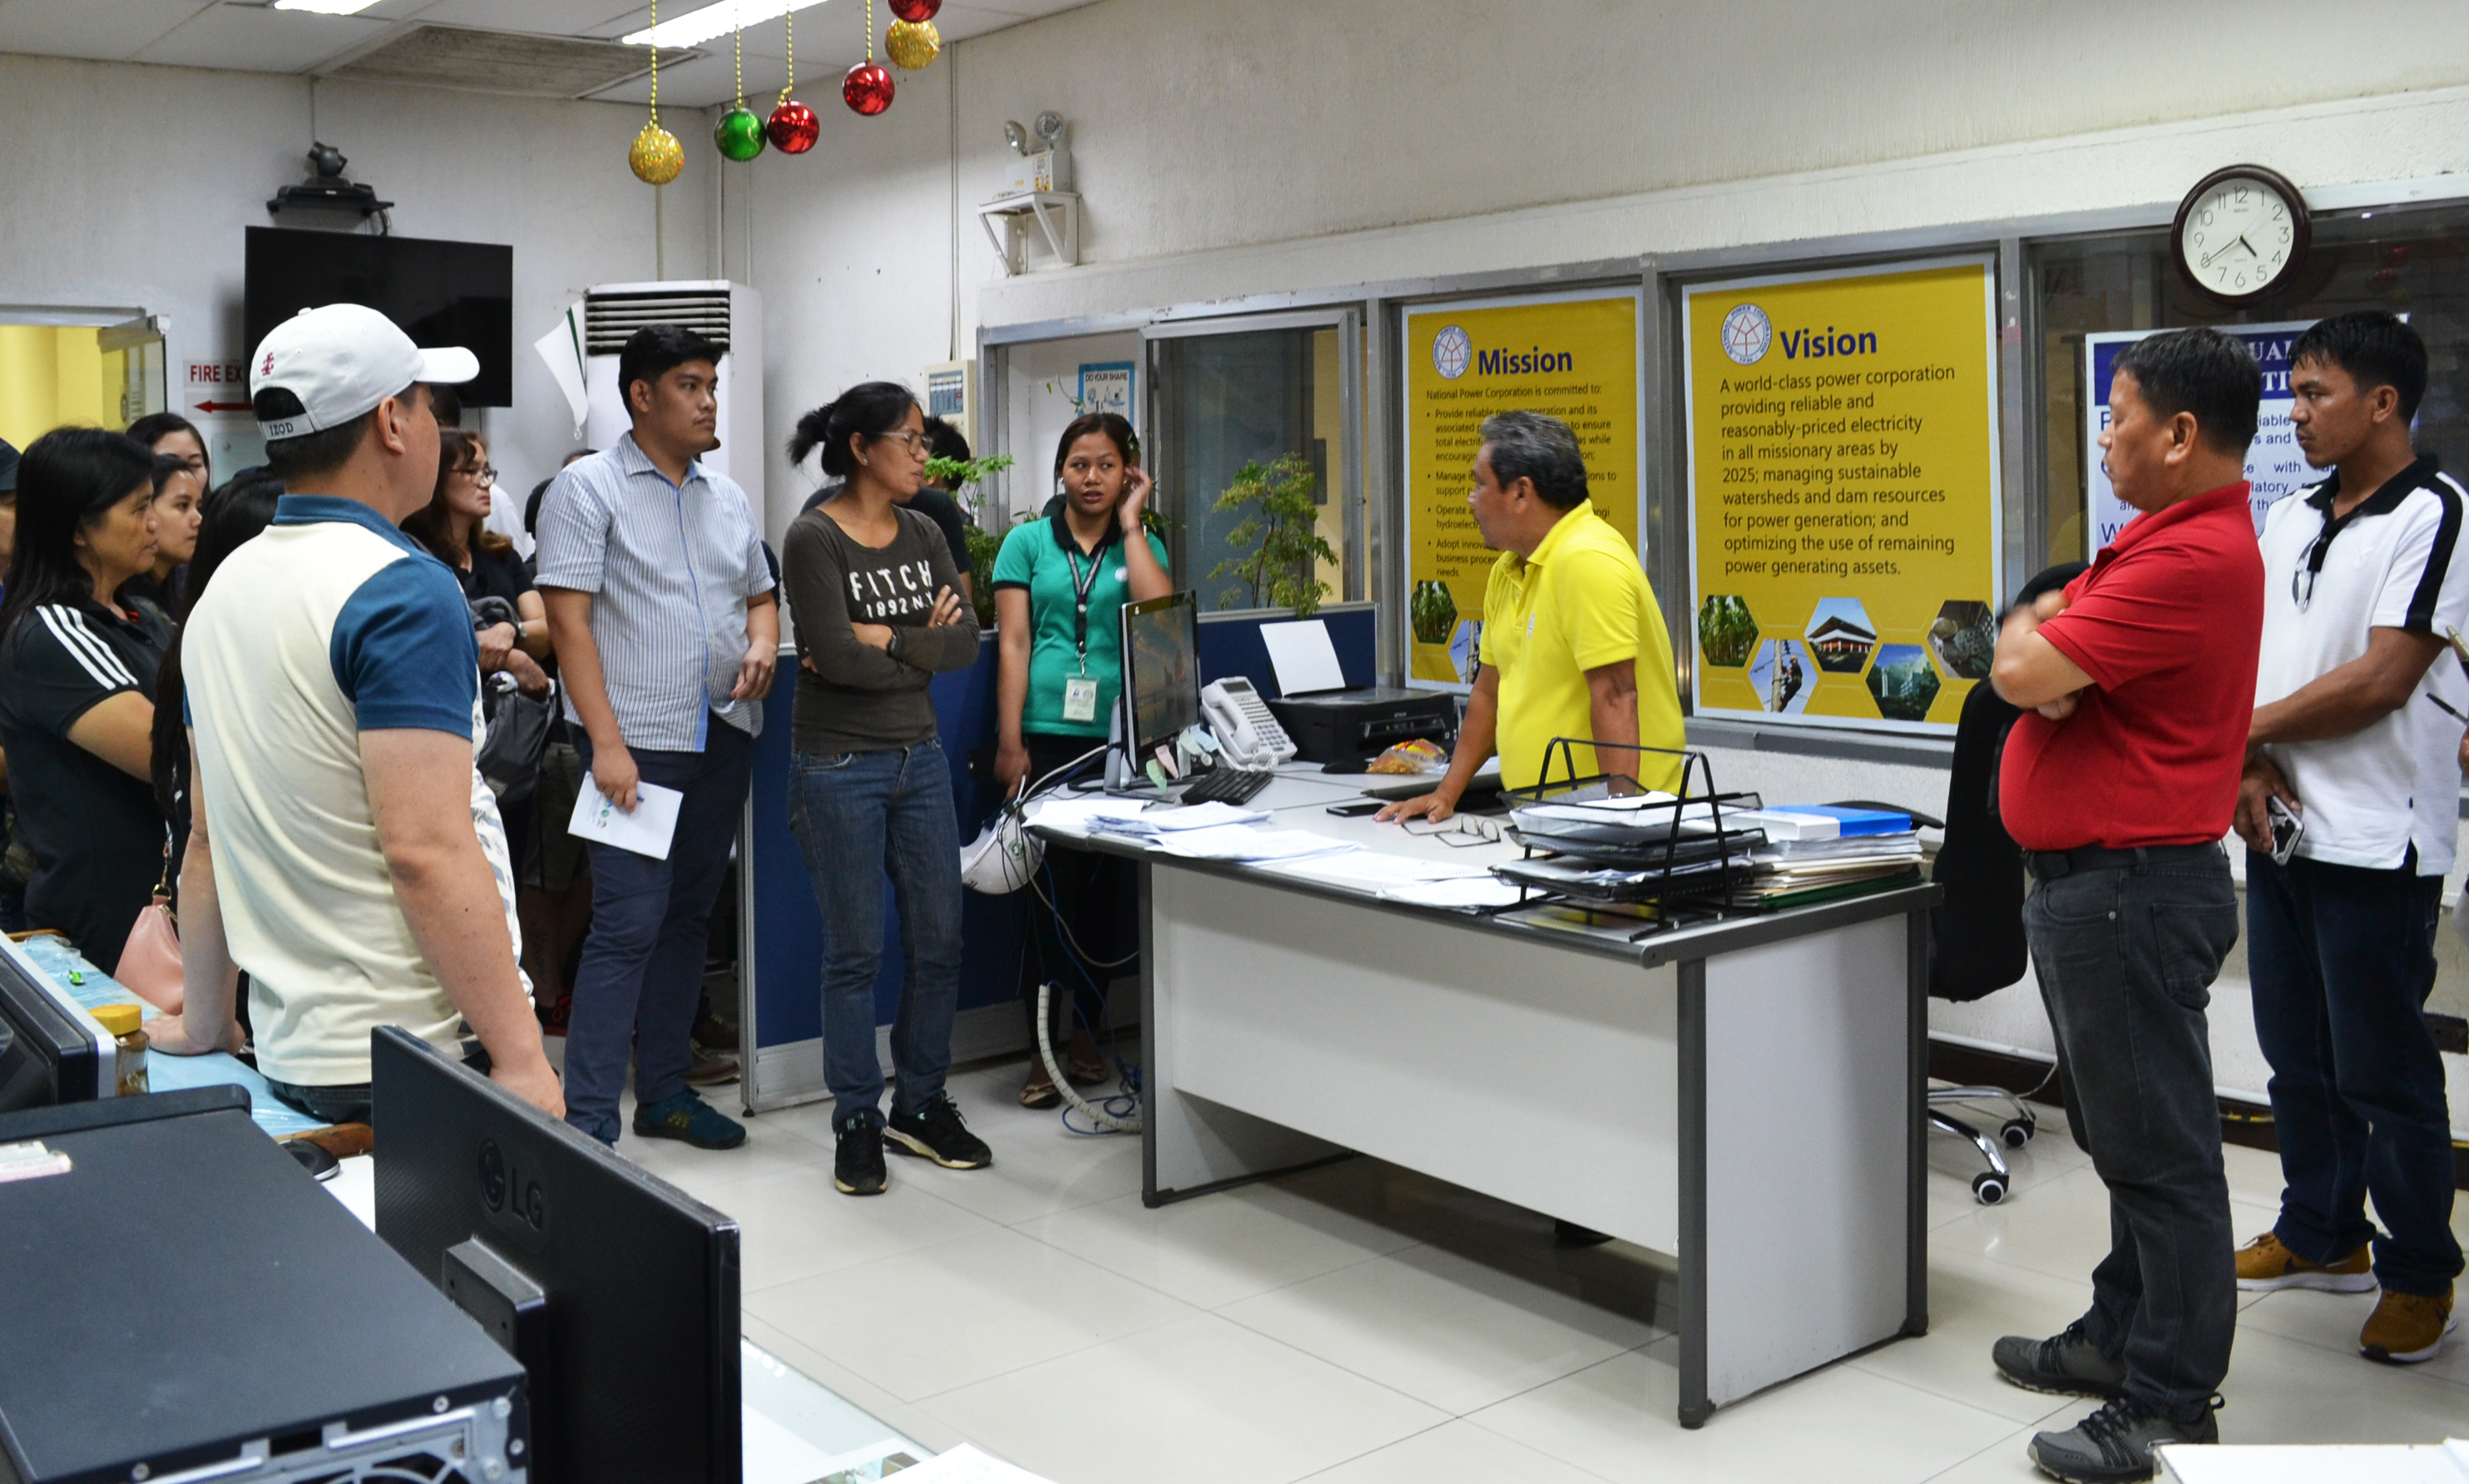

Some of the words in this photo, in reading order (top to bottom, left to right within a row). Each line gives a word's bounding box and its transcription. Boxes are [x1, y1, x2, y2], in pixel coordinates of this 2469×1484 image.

[2217, 192, 2226, 210] 11
[2234, 186, 2249, 204] 12
[2260, 190, 2265, 207] 1
[2198, 210, 2214, 227] 10
[2273, 204, 2283, 221] 2
[2194, 231, 2204, 249] 9
[2279, 226, 2289, 244] 3
[2200, 252, 2210, 269] 8
[2271, 250, 2282, 266] 4
[2218, 266, 2227, 284] 7
[2235, 271, 2246, 288] 6
[2256, 265, 2267, 282] 5
[1779, 325, 1878, 360] Vision
[1478, 346, 1573, 376] Mission
[190, 364, 220, 382] FIRE
[225, 364, 243, 382] EX
[1085, 373, 1094, 382] DO
[1095, 372, 1108, 382] YOUR
[1109, 371, 1128, 380] SHARE
[1720, 378, 1730, 393] A
[1734, 374, 1812, 393] world-class
[1816, 372, 1861, 391] power
[1866, 364, 1956, 388] corporation
[1427, 389, 1457, 399] National
[1460, 388, 1483, 398] Power
[1486, 386, 1532, 399] Corporation
[1535, 385, 1541, 396] is
[1544, 383, 1588, 396] committed
[1591, 384, 1601, 394] to:
[1436, 408, 1463, 418] Provide
[1466, 408, 1494, 418] reliable
[1568, 404, 1585, 415] and
[1587, 403, 1597, 414] its
[1721, 398, 1786, 419] providing
[1790, 394, 1843, 413] reliable
[1847, 392, 1874, 409] and
[1436, 423, 1474, 433] associated
[1571, 421, 1580, 430] to
[1582, 421, 1611, 430] ensure
[1721, 418, 1846, 440] reasonably-priced
[1851, 414, 1923, 434] electricity
[2259, 414, 2291, 427] iable
[269, 423, 294, 437] IZOD
[2266, 432, 2291, 444] and
[1436, 437, 1452, 447] total
[1455, 437, 1482, 447] electrif
[1589, 433, 1611, 444] while
[1436, 452, 1477, 463] encouragin
[1722, 446, 1734, 461] in
[1739, 444, 1754, 460] all
[1758, 442, 1833, 462] missionary
[1837, 443, 1875, 458] areas
[1880, 439, 1898, 459] by
[1723, 467, 1759, 485] 2025;
[1764, 465, 1833, 486] managing
[1838, 463, 1922, 481] sustainable
[2274, 460, 2301, 473] with
[1436, 471, 1466, 482] Manage
[1607, 471, 1616, 481] to
[1436, 487, 1466, 497] support
[1723, 490, 1800, 506] watersheds
[1804, 487, 1831, 504] and
[1836, 487, 1868, 503] dam
[1873, 489, 1946, 503] resources
[2251, 481, 2288, 495] latory
[1436, 505, 1466, 516] Operate
[1436, 519, 1480, 531] hydroelectr
[1724, 512, 1743, 528] for
[1747, 513, 1789, 532] power
[1794, 511, 1876, 532] generation;
[1881, 511, 1909, 527] and
[1436, 539, 1459, 549] Adopt
[1724, 534, 1797, 555] optimizing
[1802, 535, 1824, 551] the
[1829, 537, 1853, 551] use
[1858, 534, 1874, 551] of
[1878, 534, 1955, 556] remaining
[1437, 554, 1468, 562] business
[1725, 560, 1767, 576] power
[1772, 558, 1848, 578] generating
[1853, 560, 1901, 575] assets.
[849, 559, 933, 601] FITCH
[866, 597, 908, 619] 1892
[512, 1167, 543, 1232] LG
